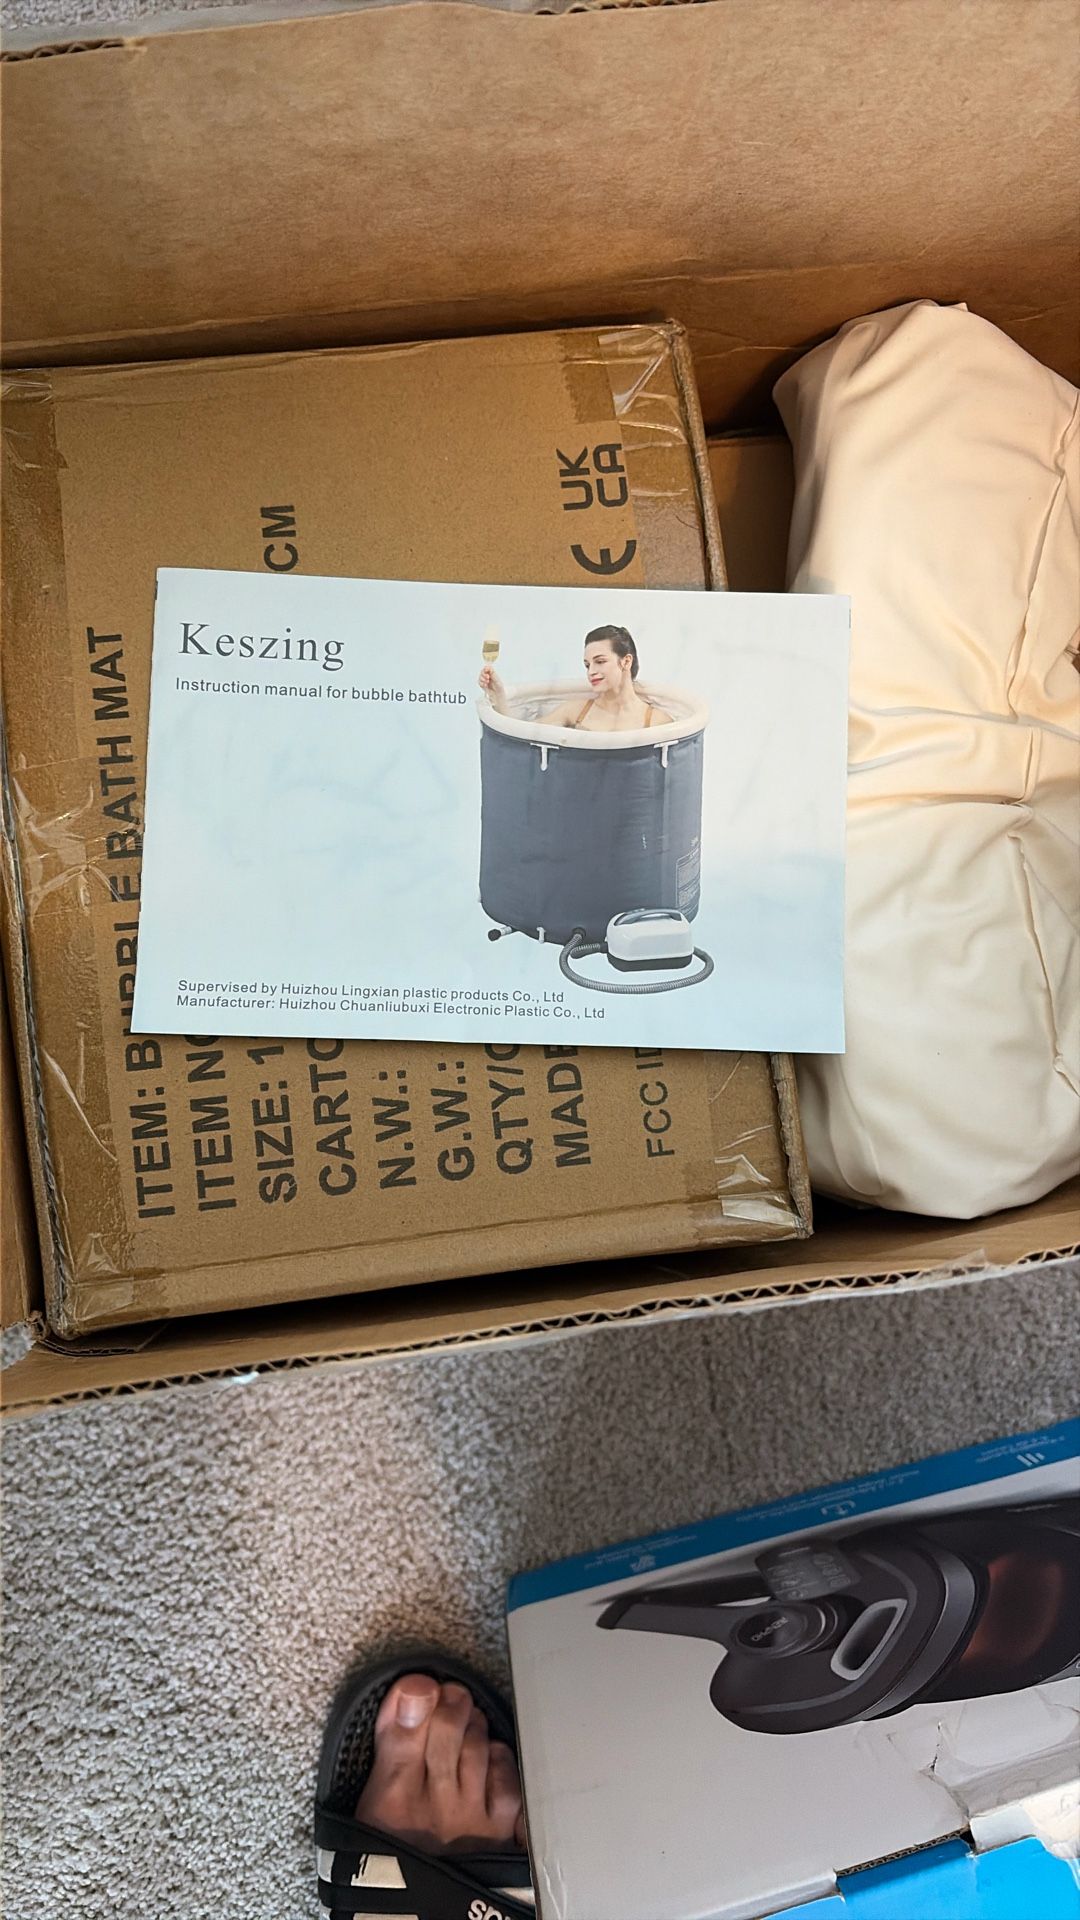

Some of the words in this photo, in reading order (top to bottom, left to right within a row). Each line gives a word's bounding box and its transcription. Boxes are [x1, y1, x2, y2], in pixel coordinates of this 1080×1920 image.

[556, 446, 593, 510] UK
[593, 443, 628, 507] CA
[260, 505, 299, 572] CM
[87, 626, 129, 721] MAT
[178, 622, 345, 671] Keszing
[175, 677, 260, 694] Instruction
[264, 685, 322, 698] manual
[326, 686, 348, 698] for
[351, 687, 404, 701] bubble
[408, 690, 467, 704] bathtub
[97, 735, 143, 860] BATH
[176, 995, 275, 1009] Manufacturer:
[279, 998, 336, 1011] Huizhou
[340, 999, 430, 1013] Chuanliubuxi
[433, 1002, 501, 1016] Electronic
[504, 1005, 550, 1017] Plastic
[553, 1006, 581, 1020] Co.,
[584, 1007, 605, 1019] Ltd
[178, 979, 258, 995] Supervised
[261, 983, 278, 996] by
[281, 983, 338, 996] Huizhou
[341, 985, 400, 999] Lingxian
[403, 987, 447, 1000] plastic
[450, 989, 509, 1003] products
[512, 990, 540, 1003] Co.,
[543, 991, 564, 1003] Ltd
[130, 1086, 176, 1219] ITEM:
[190, 1095, 237, 1212] ITEM
[252, 1079, 298, 1203] SIZE:
[371, 1069, 417, 1190] N.W.:
[430, 1061, 475, 1182] G.W.:
[639, 1080, 675, 1158] FCC
